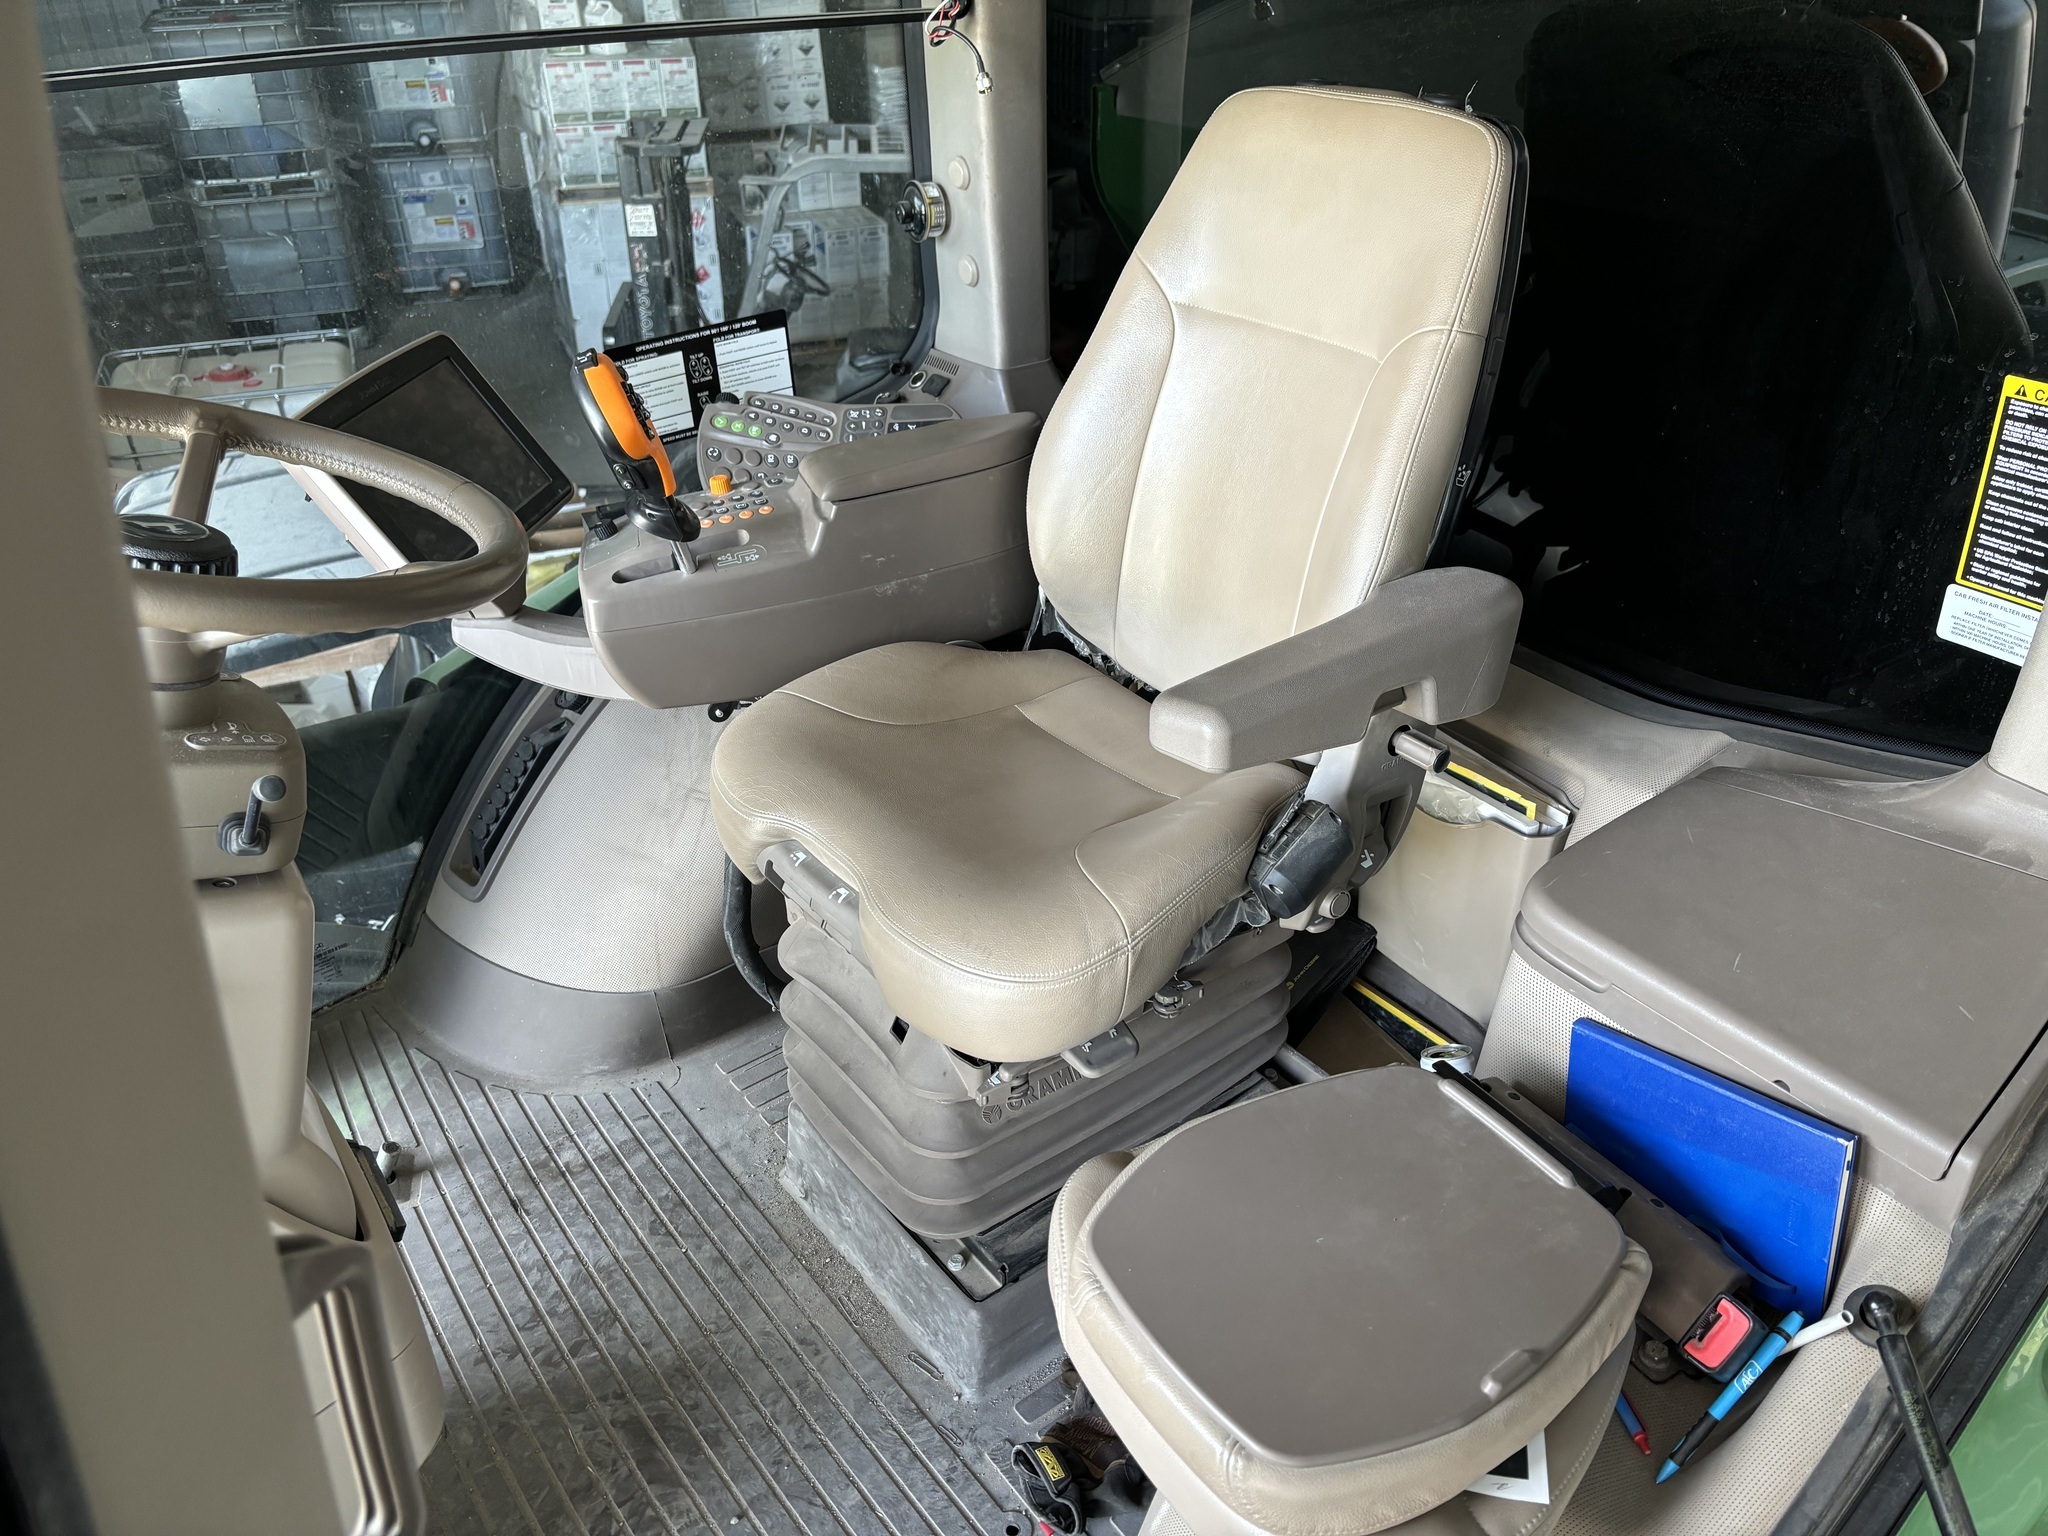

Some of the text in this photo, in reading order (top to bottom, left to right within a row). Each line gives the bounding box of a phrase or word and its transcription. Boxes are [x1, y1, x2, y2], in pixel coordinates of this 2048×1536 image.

[637, 274, 654, 340] TOYOTA
[635, 341, 664, 353] OPERATING
[664, 332, 699, 346] INSTRUCTIONS
[700, 329, 710, 337] FOR
[742, 319, 757, 328] BOOM
[2034, 389, 2048, 402] C
[2003, 430, 2023, 439] FILTERS
[2004, 425, 2031, 435] PRESSURE
[2002, 435, 2028, 445] CHEMICAL
[2005, 446, 2023, 455] reduce
[768, 454, 775, 463] R3
[787, 454, 794, 464] R2
[2009, 458, 2037, 469] PERSONAL
[1996, 460, 2025, 472] EQUIPMENT
[2010, 558, 2035, 570] Protection
[1954, 591, 1967, 599] CAB
[1968, 595, 1988, 606] FRESH
[1989, 602, 2000, 610] AIR
[2000, 606, 2021, 617] FILTER
[1951, 615, 1971, 624] REPLACE
[1964, 611, 2008, 629] MACHINE HOURS:
[1974, 633, 1992, 642] MACHINE
[1985, 642, 2020, 656] MANUFACTURER
[1294, 954, 1320, 982] JOHN DEERE
